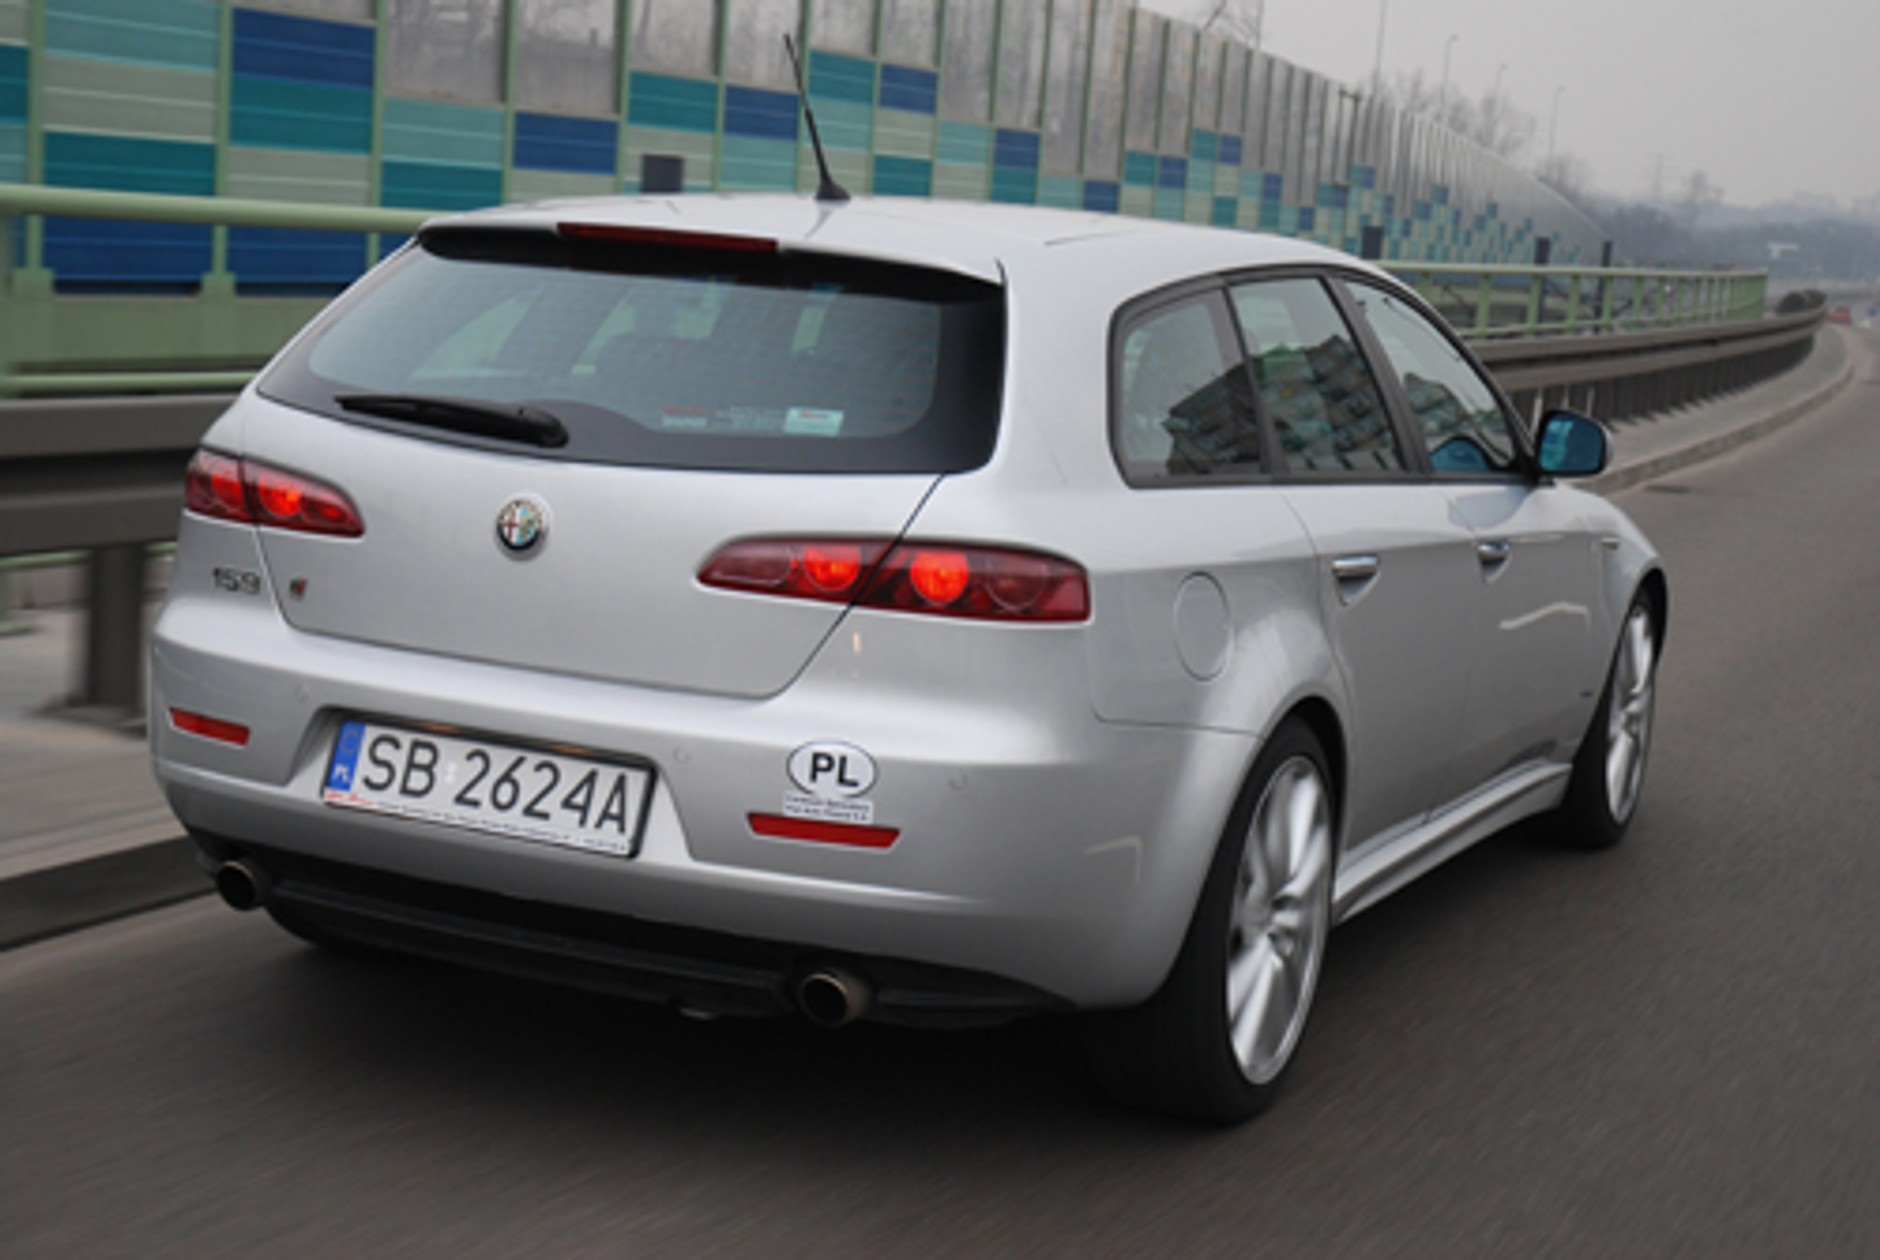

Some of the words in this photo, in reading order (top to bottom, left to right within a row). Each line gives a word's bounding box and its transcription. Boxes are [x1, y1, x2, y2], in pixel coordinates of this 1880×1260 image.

[213, 567, 260, 595] 159
[363, 735, 439, 798] SB
[454, 749, 628, 834] 2624A
[809, 752, 859, 788] PL
